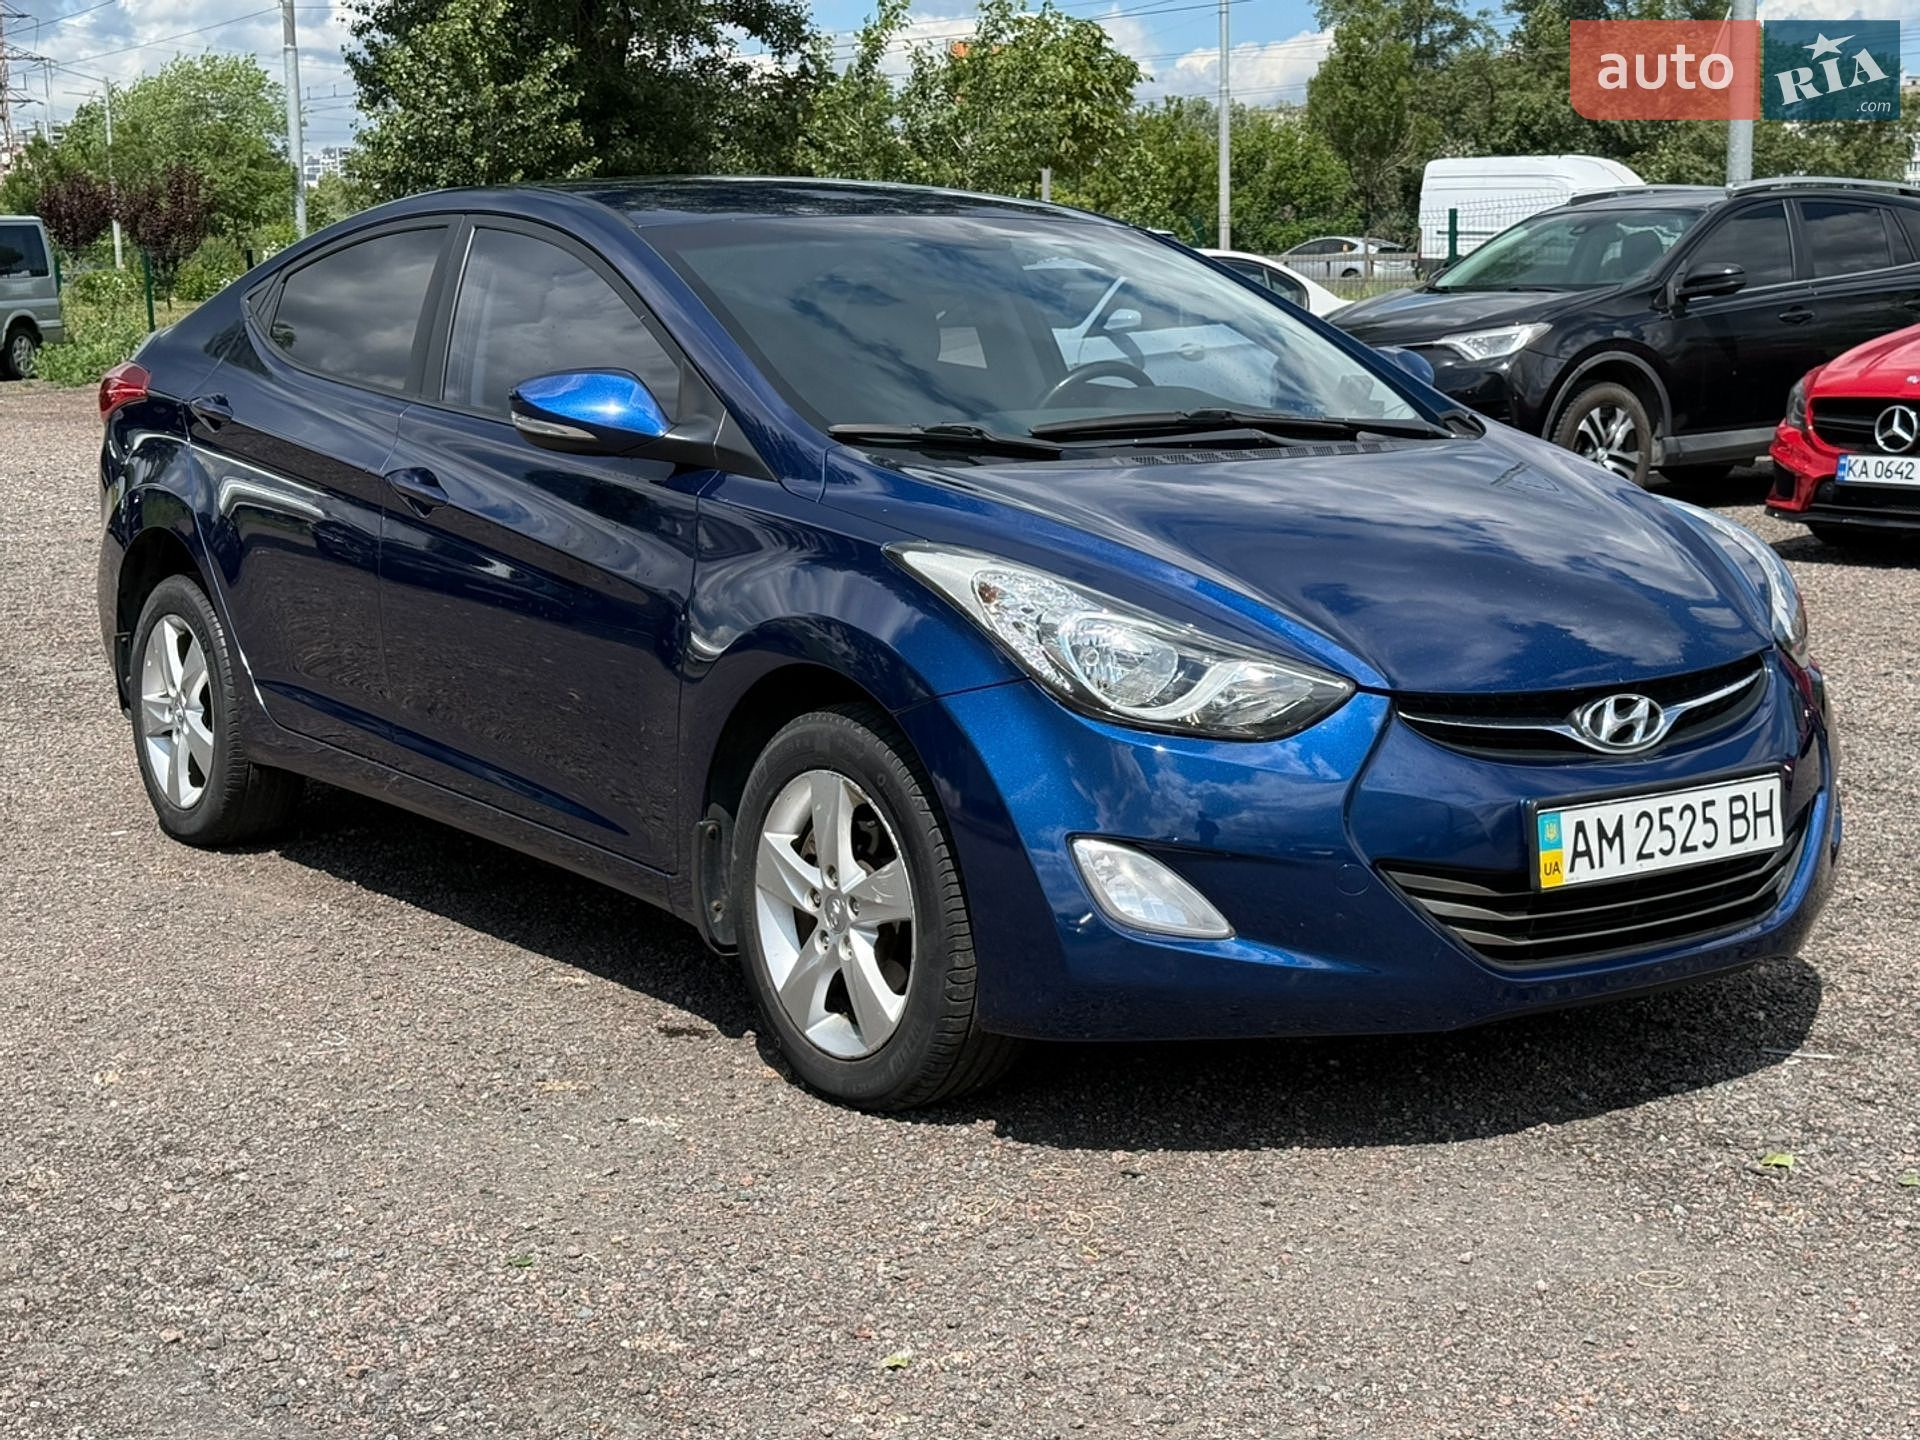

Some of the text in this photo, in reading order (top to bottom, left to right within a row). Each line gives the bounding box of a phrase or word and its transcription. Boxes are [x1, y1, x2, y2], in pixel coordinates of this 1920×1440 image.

[1846, 459, 1915, 480] KA 0642
[1569, 788, 1775, 873] AM 2525 BH
[1544, 861, 1561, 876] UA
